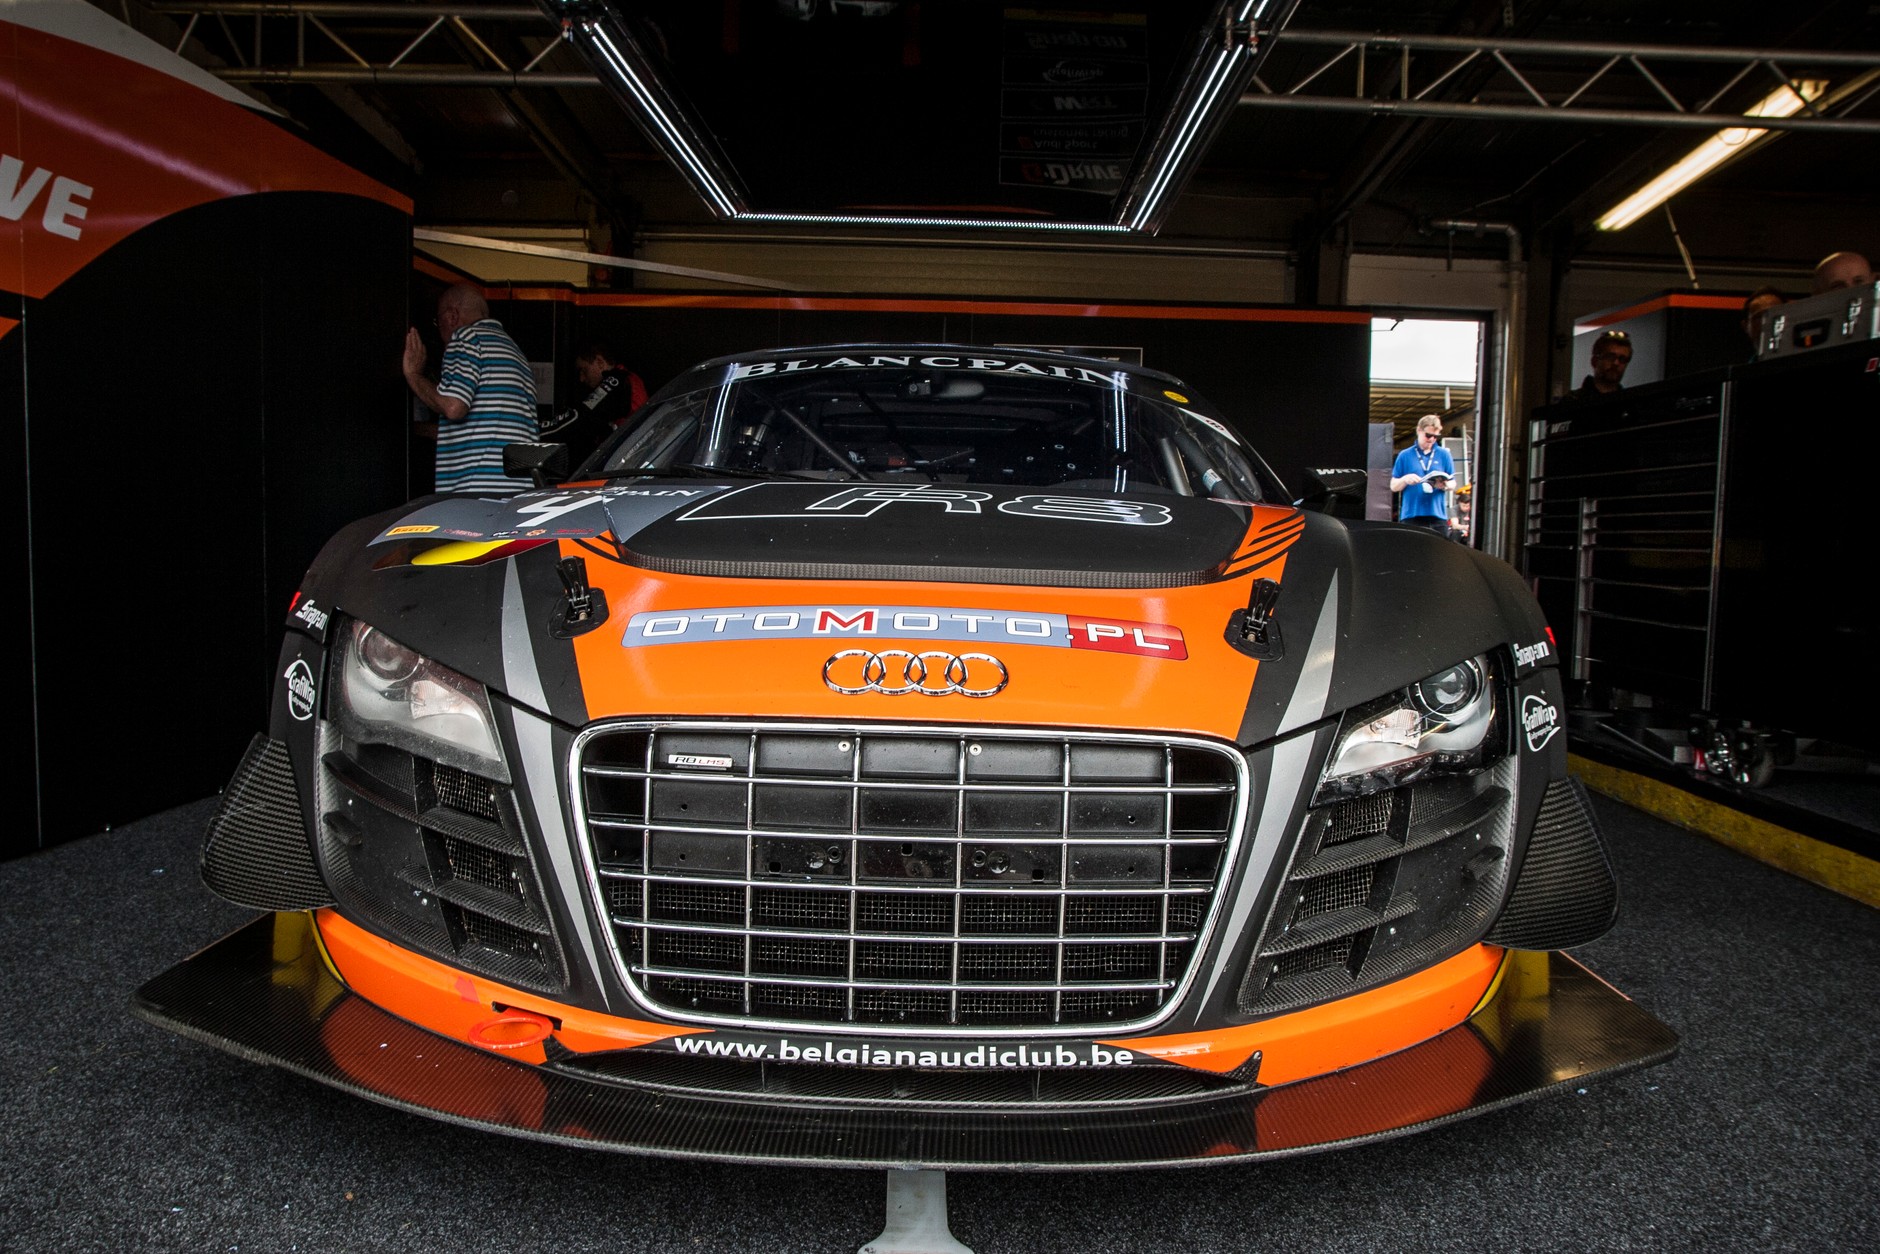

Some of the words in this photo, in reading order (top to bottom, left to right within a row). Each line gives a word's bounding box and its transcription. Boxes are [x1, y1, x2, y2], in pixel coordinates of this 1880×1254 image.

[729, 355, 1128, 390] BLANCPAIN
[516, 494, 616, 528] 4
[673, 1035, 1134, 1067] www.belgianaudiclub.be
